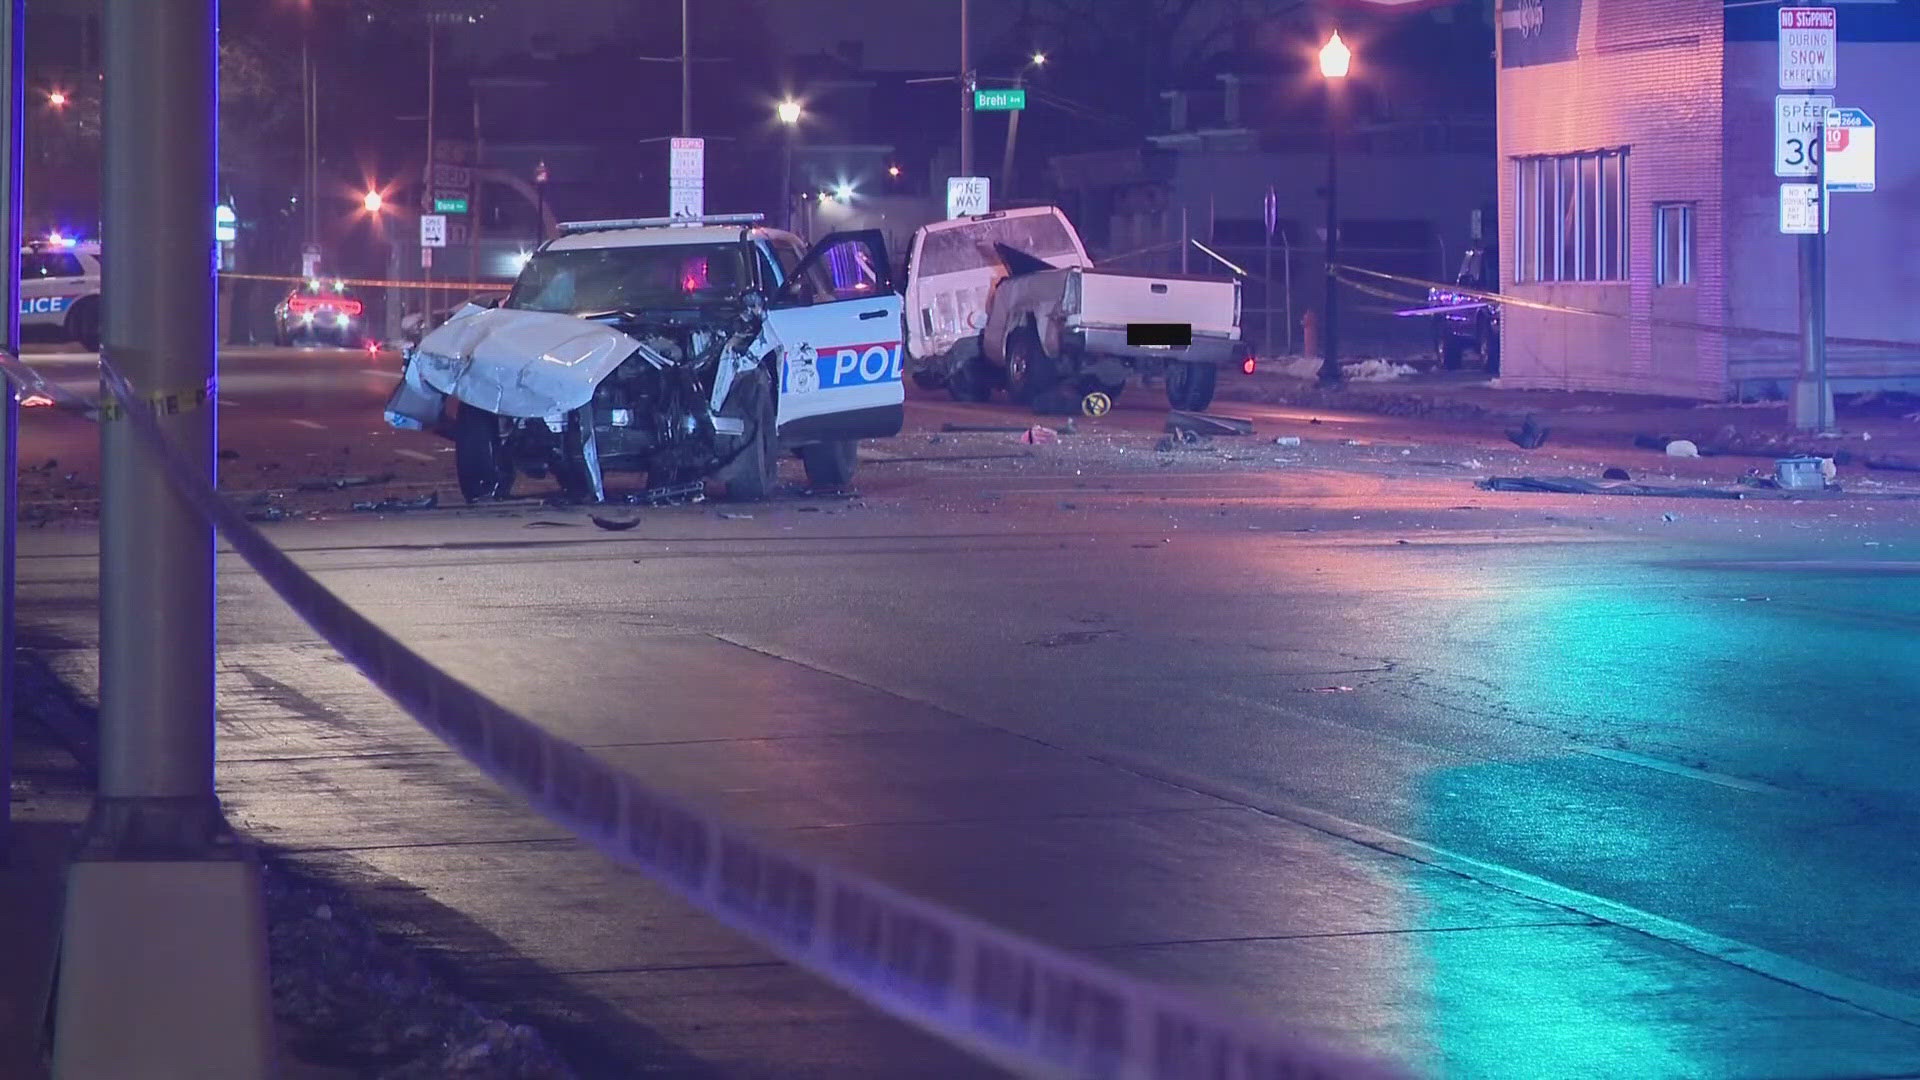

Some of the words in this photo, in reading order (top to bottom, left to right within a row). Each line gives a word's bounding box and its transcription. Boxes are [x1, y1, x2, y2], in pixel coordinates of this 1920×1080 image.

[1782, 11, 1794, 27] NO
[1796, 11, 1833, 27] STOPPING
[1789, 34, 1827, 46] DURING
[1791, 50, 1826, 65] SNOW
[1784, 69, 1832, 81] EMERGENCY
[979, 94, 1007, 106] Brehl
[1826, 129, 1842, 142] 10
[956, 183, 982, 194] ONE
[956, 196, 981, 207] WAY
